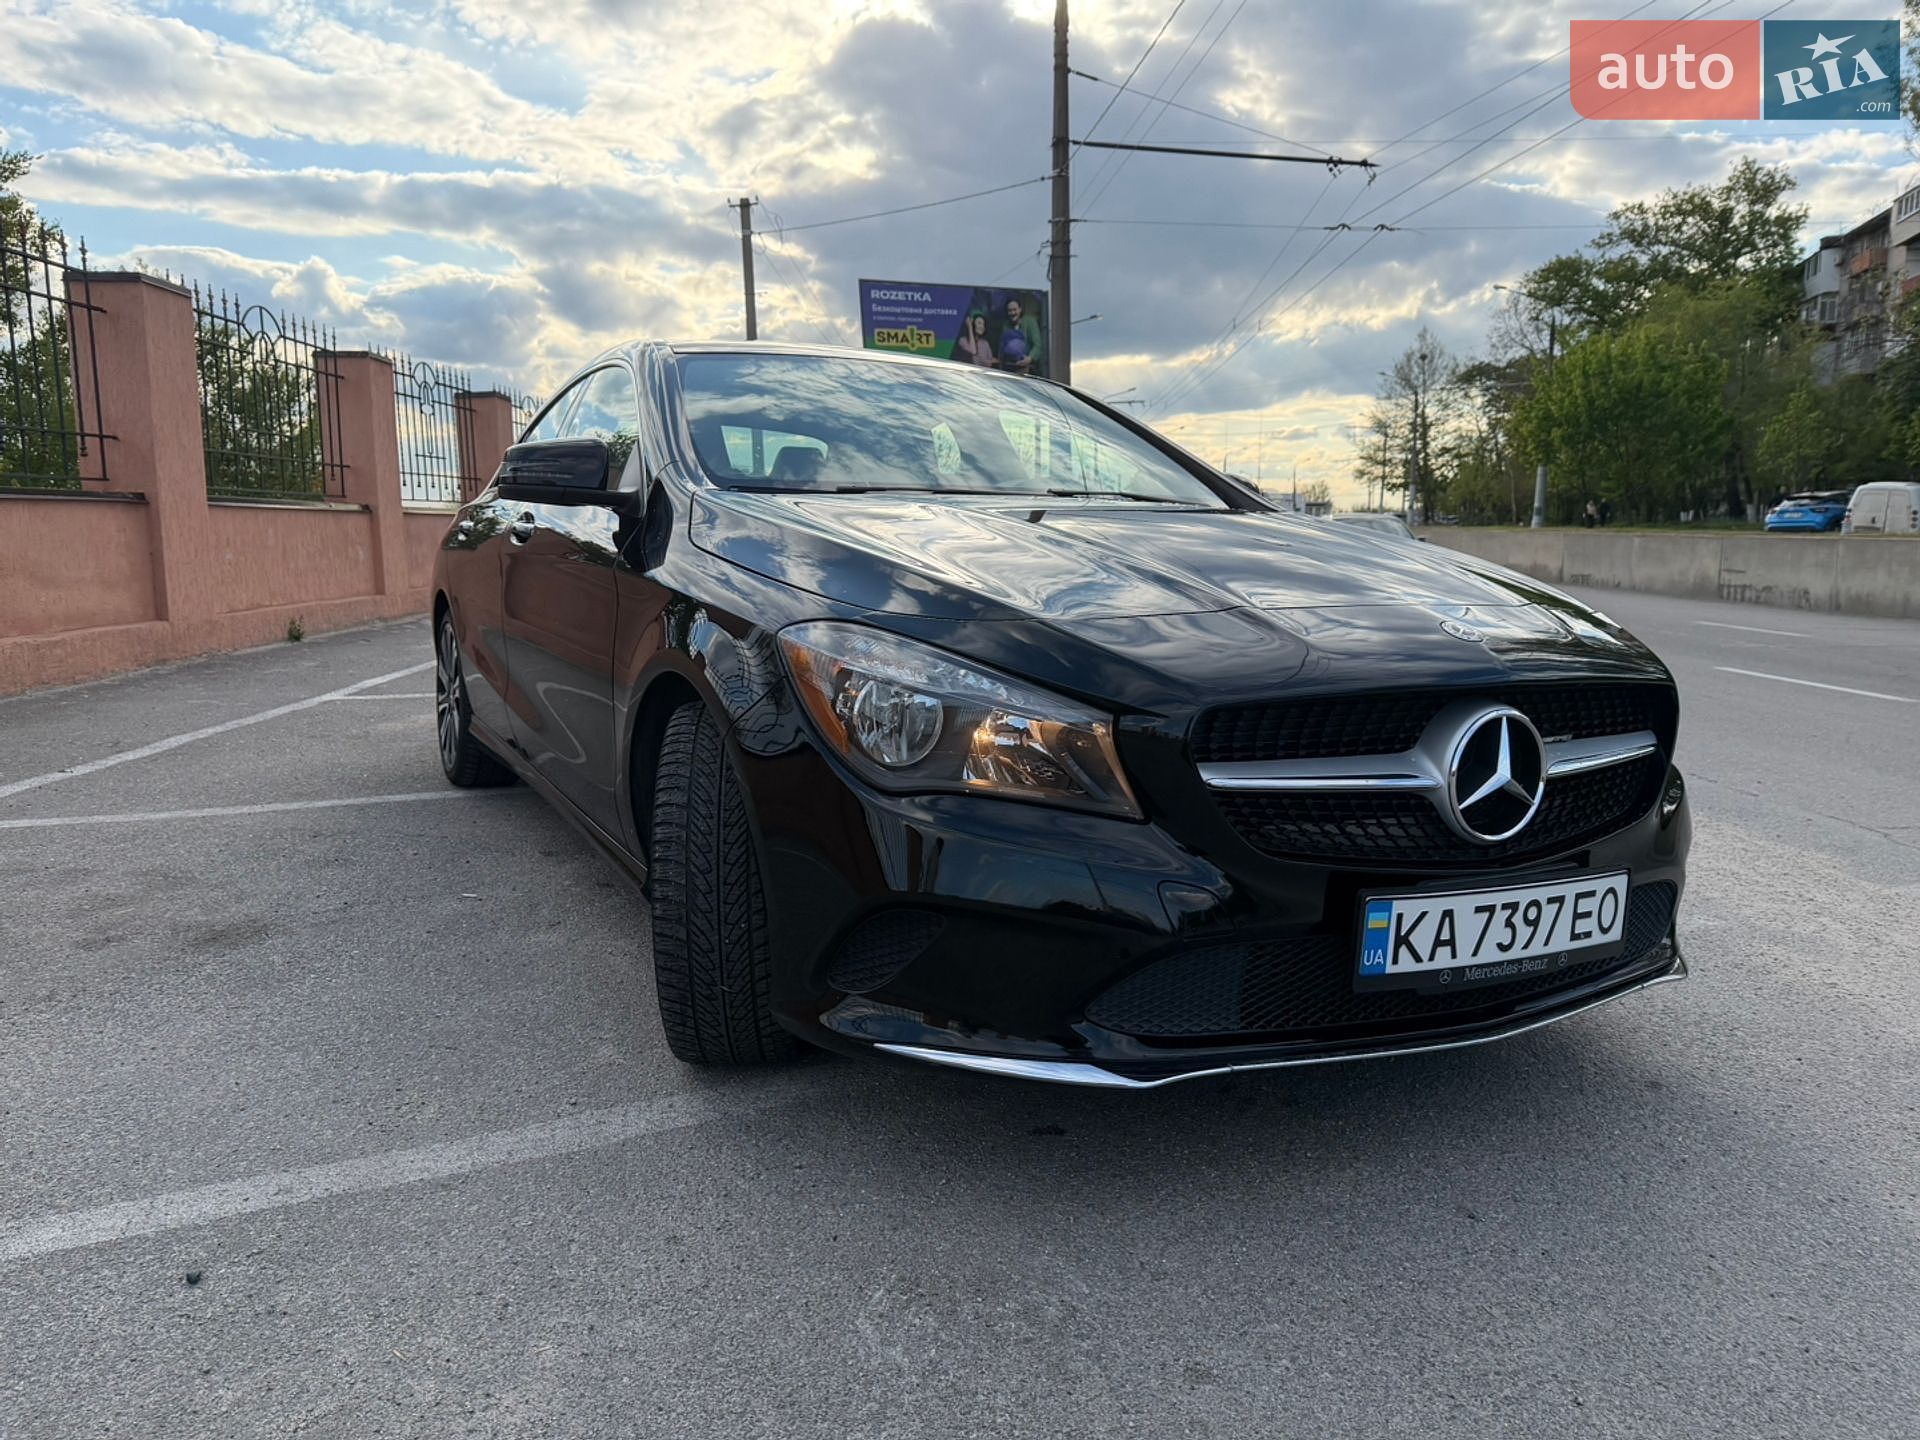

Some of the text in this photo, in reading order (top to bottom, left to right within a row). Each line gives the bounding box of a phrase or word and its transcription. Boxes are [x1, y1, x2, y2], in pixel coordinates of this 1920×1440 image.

[871, 289, 931, 301] ROZETKA
[1391, 886, 1619, 965] KA 7397 EO
[1364, 949, 1384, 966] UA
[1463, 956, 1549, 981] Mercedes-Benz
